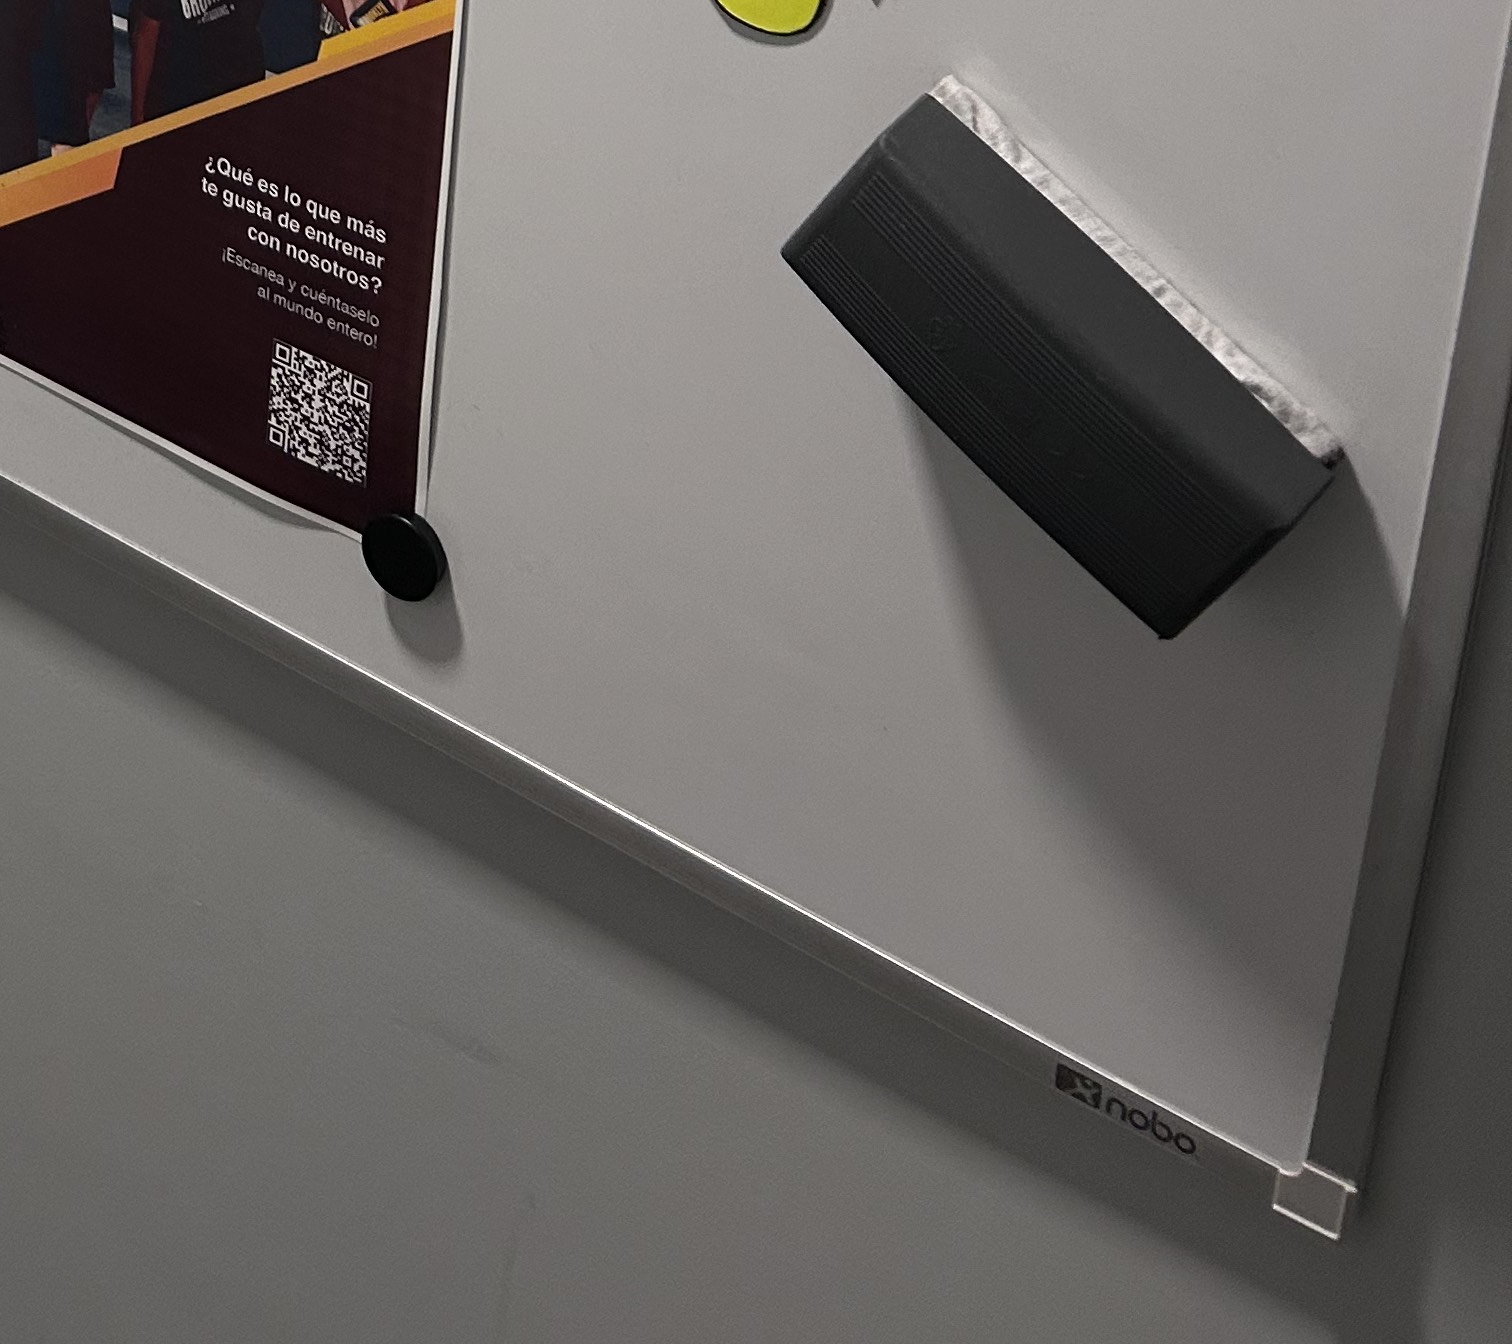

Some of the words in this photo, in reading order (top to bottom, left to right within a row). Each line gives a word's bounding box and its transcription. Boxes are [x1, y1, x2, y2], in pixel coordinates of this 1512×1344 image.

[201, 176, 218, 196] te
[223, 189, 272, 221] gusta
[278, 212, 300, 233] de
[305, 226, 385, 269] entrenar
[205, 156, 253, 186] ¿Qué
[257, 176, 279, 198] es
[284, 185, 301, 207] lo
[306, 198, 341, 224] que
[347, 219, 387, 244] más
[222, 246, 284, 286] ¡Escanea
[288, 278, 297, 293] y
[300, 284, 380, 327] cuéntaselo
[248, 226, 280, 252] con
[286, 242, 382, 294] nosotros?
[257, 285, 270, 301] al
[273, 294, 323, 324] mundo
[327, 318, 378, 348] entero!
[1106, 1097, 1196, 1154] nobo
